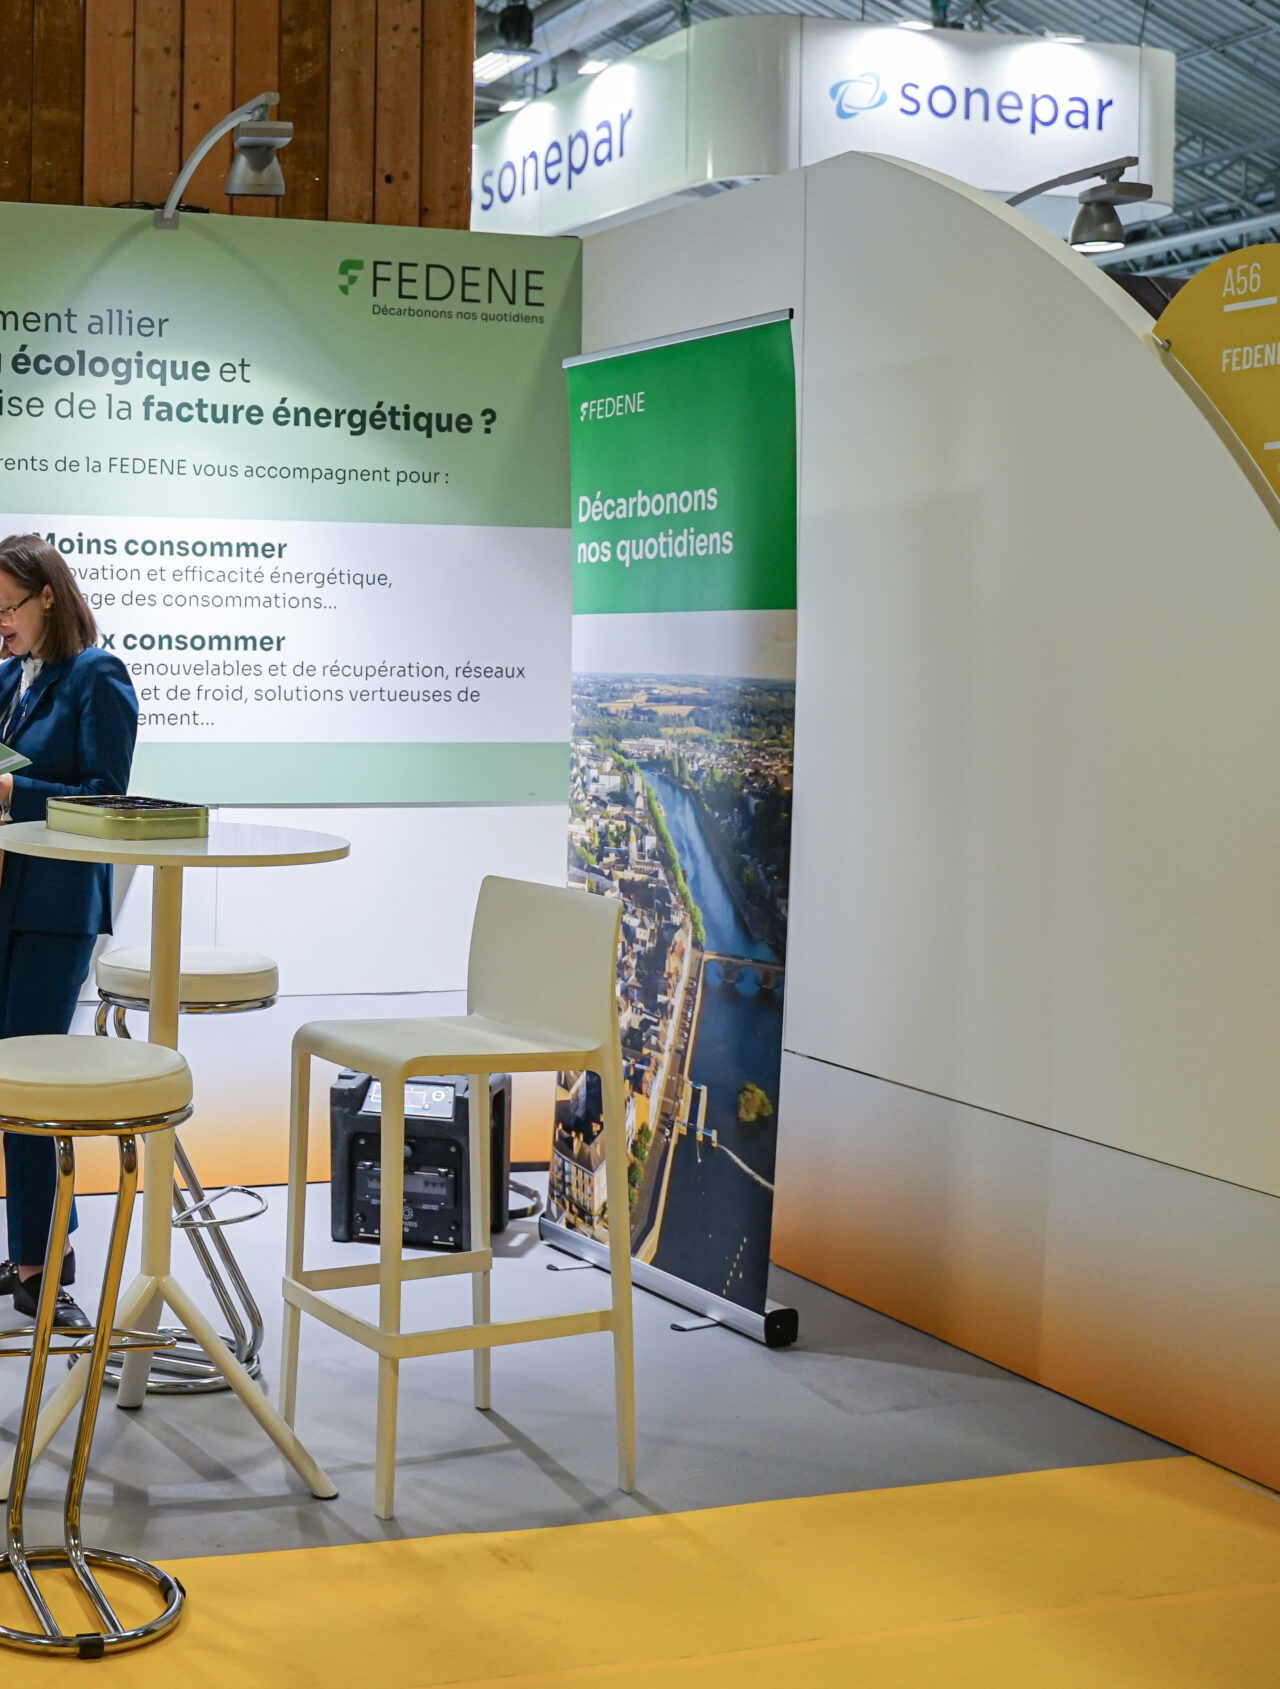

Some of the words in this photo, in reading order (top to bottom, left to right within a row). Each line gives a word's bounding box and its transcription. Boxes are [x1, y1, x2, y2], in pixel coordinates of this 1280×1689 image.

[899, 79, 1113, 134] sonepar
[480, 106, 634, 212] sonepar
[371, 260, 546, 308] FEDENE
[1222, 262, 1261, 298] A56
[87, 307, 169, 338] allier
[372, 304, 452, 322] Décarbonons
[455, 311, 477, 322] nos
[480, 309, 545, 326] quotidiens
[11, 343, 211, 387] écologique
[219, 356, 251, 384] et
[1222, 341, 1280, 373] FEDEN
[54, 390, 97, 420] de
[106, 392, 133, 421] la
[142, 395, 264, 428] facture
[272, 396, 473, 437] énergétique
[480, 407, 497, 435] ?
[588, 392, 645, 421] FEDENE
[54, 455, 81, 474] de
[86, 456, 103, 474] la
[108, 456, 187, 477] FEDENE
[192, 461, 238, 478] vous
[243, 461, 391, 486] accompagnent
[396, 467, 439, 487] pour
[578, 488, 718, 523] Décarbonons
[124, 537, 288, 559] consommer
[577, 540, 611, 564] nos
[616, 527, 734, 567] quotidiens
[70, 564, 140, 581] ovation
[147, 566, 166, 582] et
[172, 565, 265, 583] efficacité
[269, 566, 393, 590] énergétique,
[121, 590, 157, 607] des
[123, 632, 286, 651] consommer
[267, 661, 288, 678] et
[292, 660, 316, 678] de
[321, 660, 450, 684] récupération,
[454, 661, 526, 680] réseaux
[141, 685, 160, 701] et
[166, 684, 191, 701] de
[197, 684, 249, 704] froid,
[253, 683, 343, 702] solutions
[349, 687, 452, 703] vertueuses
[457, 684, 480, 703] de
